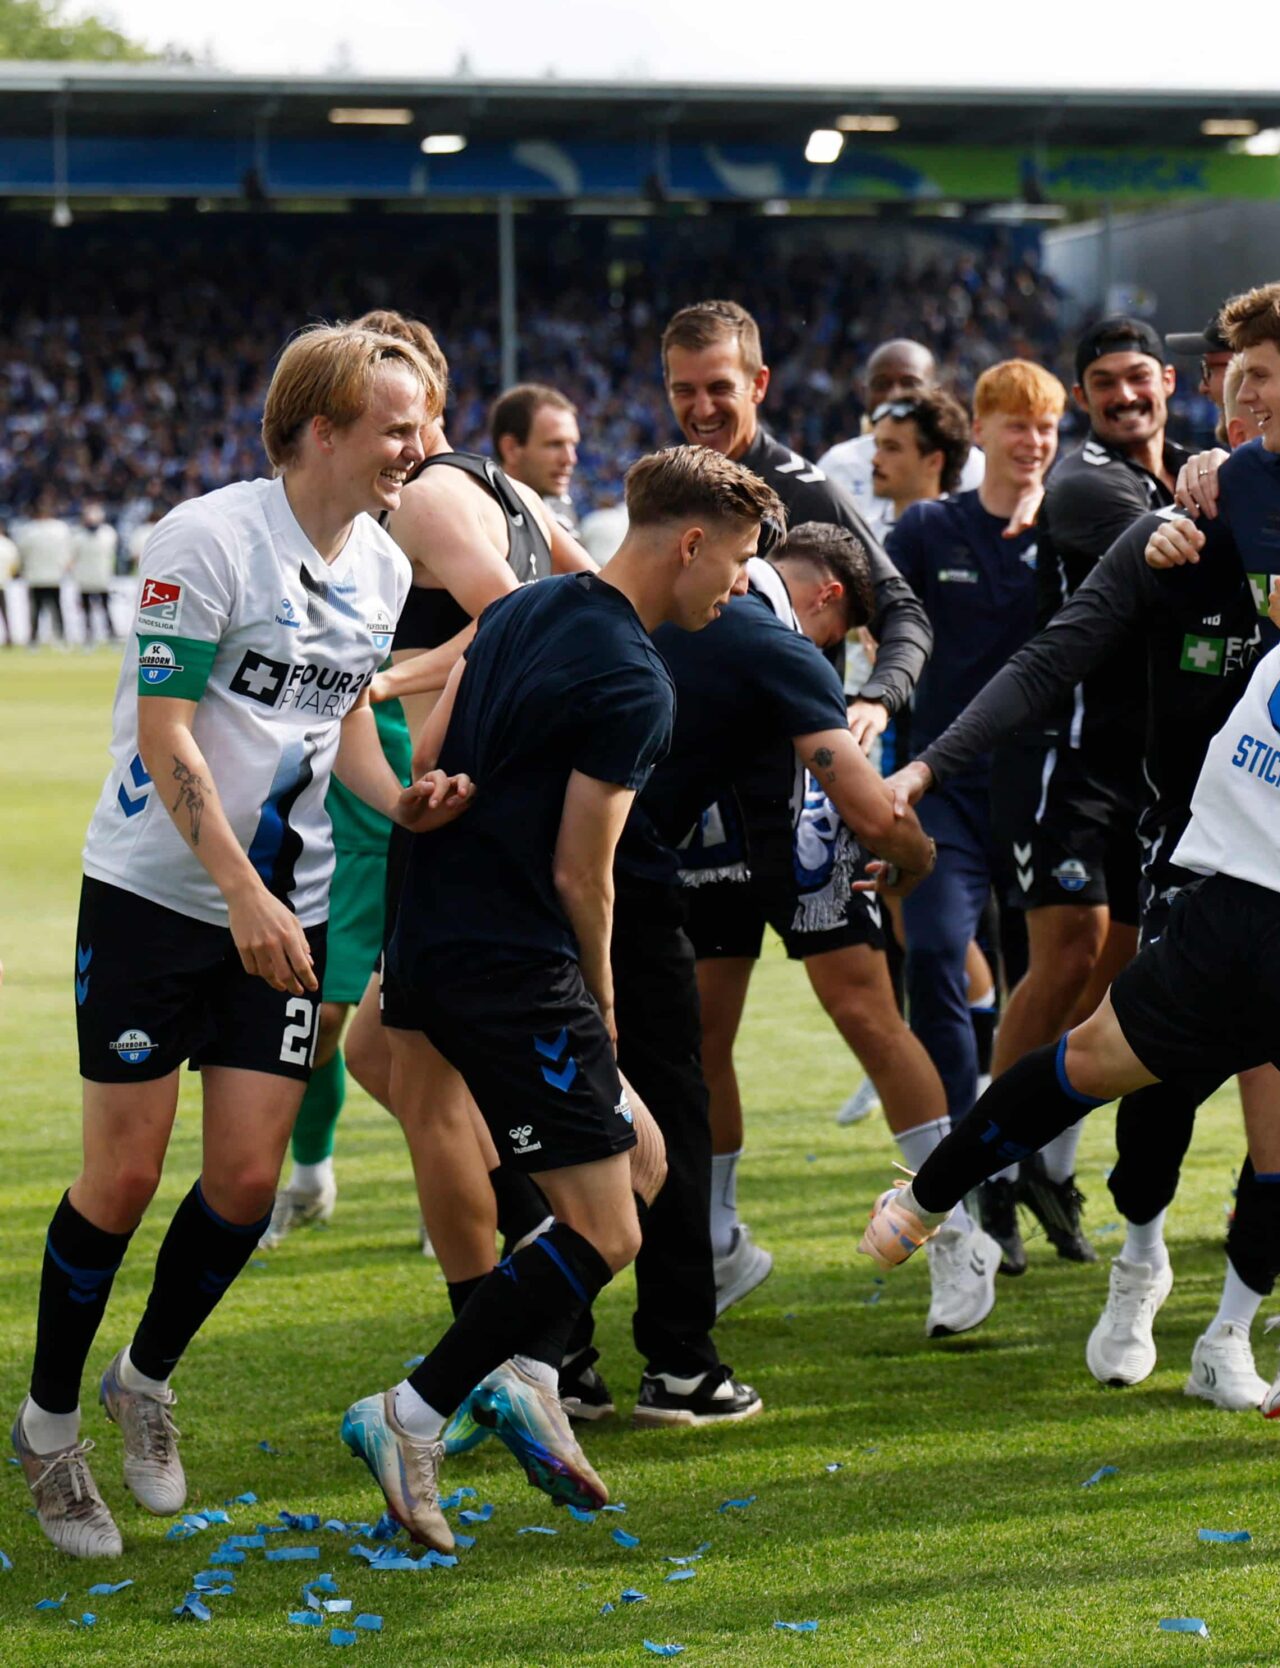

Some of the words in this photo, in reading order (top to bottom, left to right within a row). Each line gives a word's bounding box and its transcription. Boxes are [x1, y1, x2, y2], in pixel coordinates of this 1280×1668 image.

[161, 602, 175, 619] 2
[152, 645, 162, 655] SC
[148, 670, 159, 679] 07
[279, 997, 322, 1068] 2
